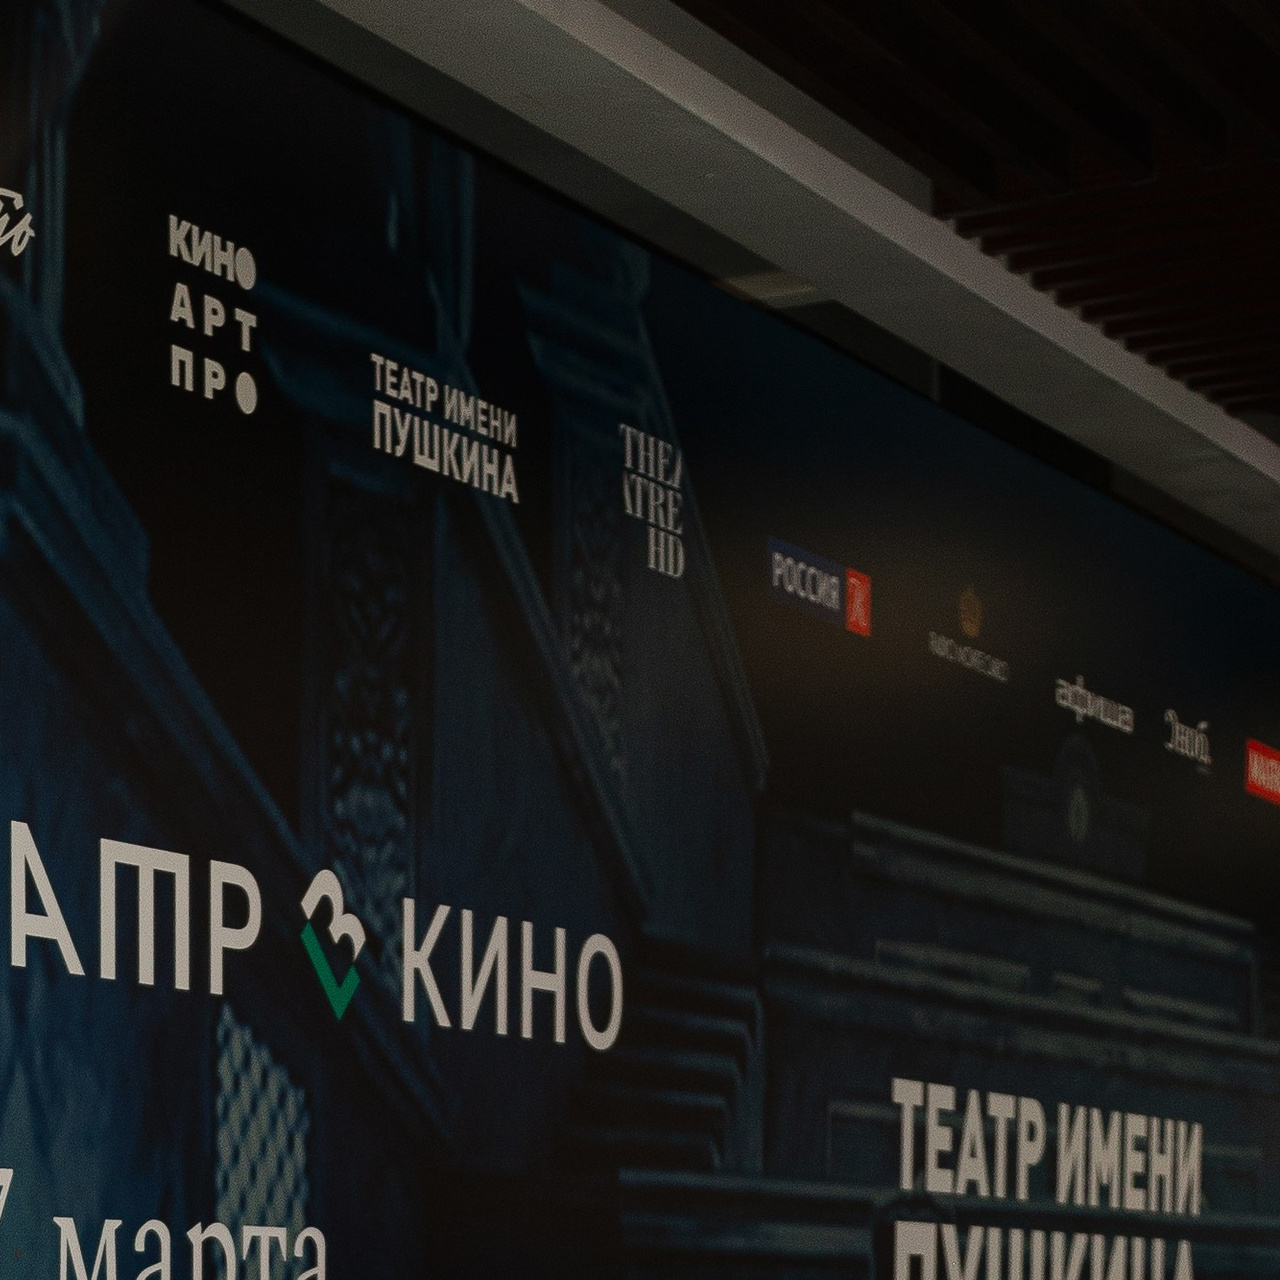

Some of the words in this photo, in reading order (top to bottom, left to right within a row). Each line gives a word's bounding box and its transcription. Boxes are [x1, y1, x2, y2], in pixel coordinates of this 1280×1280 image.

[168, 214, 257, 291] КИНО
[169, 282, 258, 352] АРТ
[170, 344, 258, 415] ПРО
[370, 352, 438, 413] ТЕАТР
[443, 383, 518, 448] ИМЕНИ
[372, 400, 520, 504] ПУШКИНА
[647, 525, 686, 579] HD
[772, 551, 841, 611] РОССИЯ
[402, 897, 624, 1051] КИНО
[891, 1077, 1047, 1202] ТЕАТР
[1055, 1102, 1204, 1218] ИМЕНИ
